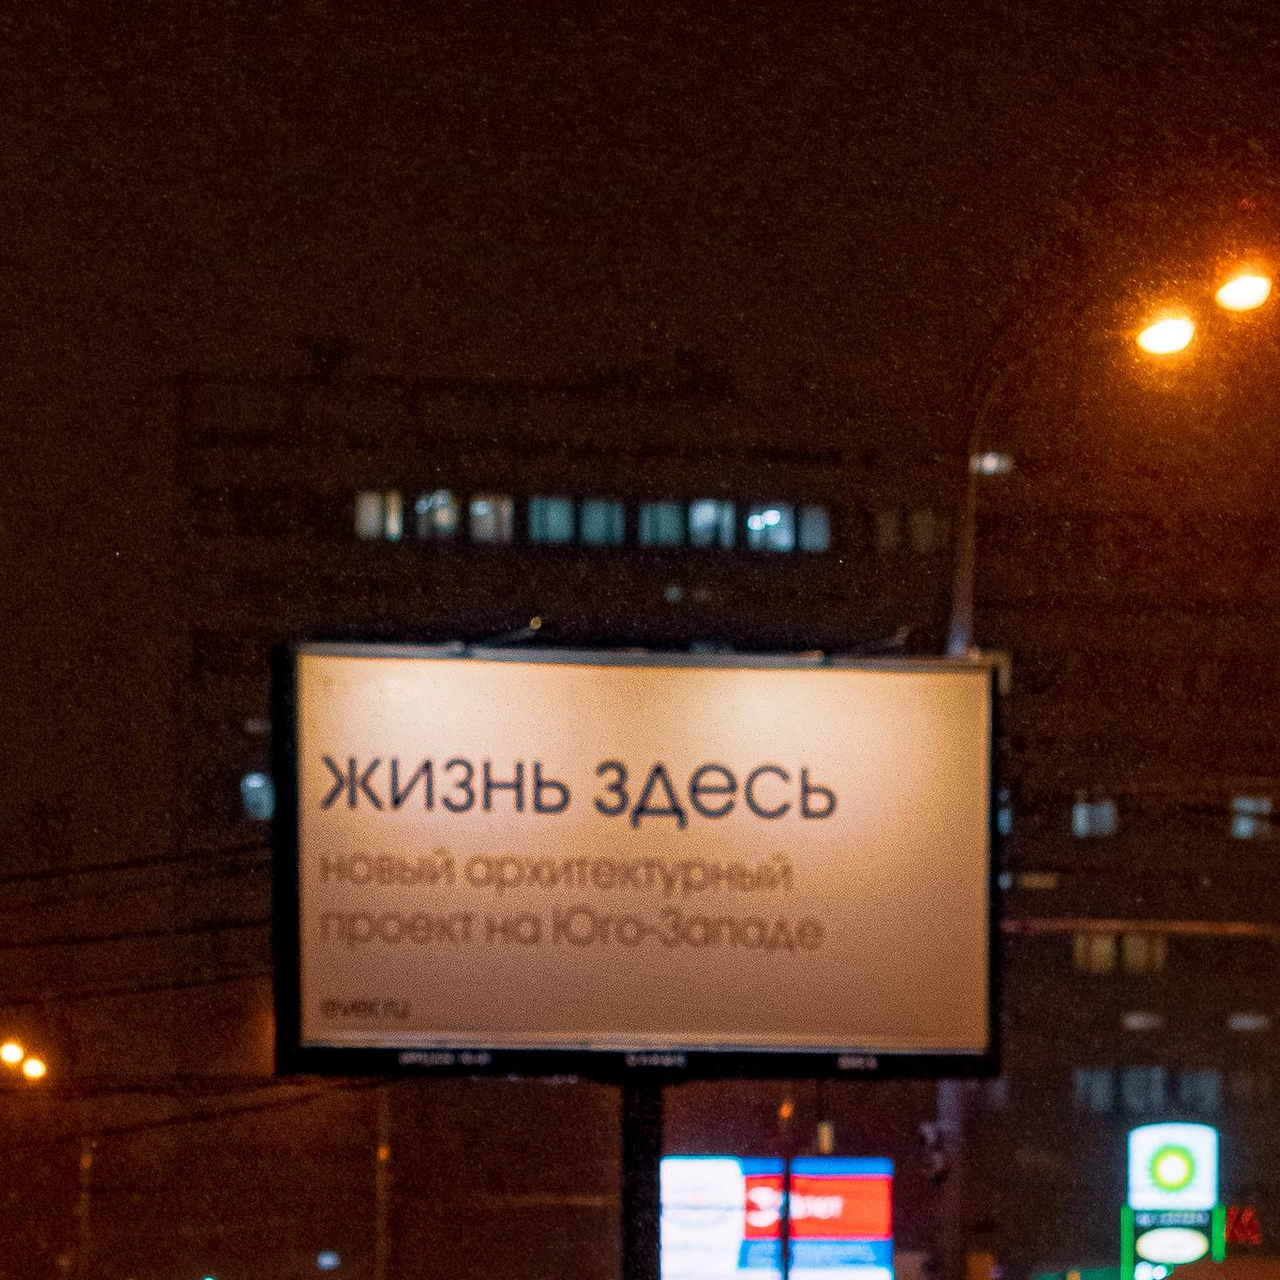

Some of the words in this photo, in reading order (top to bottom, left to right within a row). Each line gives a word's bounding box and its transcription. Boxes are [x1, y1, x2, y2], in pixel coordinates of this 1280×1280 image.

[321, 758, 571, 814] жизнь
[594, 760, 837, 829] здесь
[320, 846, 454, 886] новый
[465, 849, 794, 898] архитектурный
[321, 910, 472, 949] проект
[487, 914, 542, 946] на
[553, 903, 821, 952] Юго-Западе
